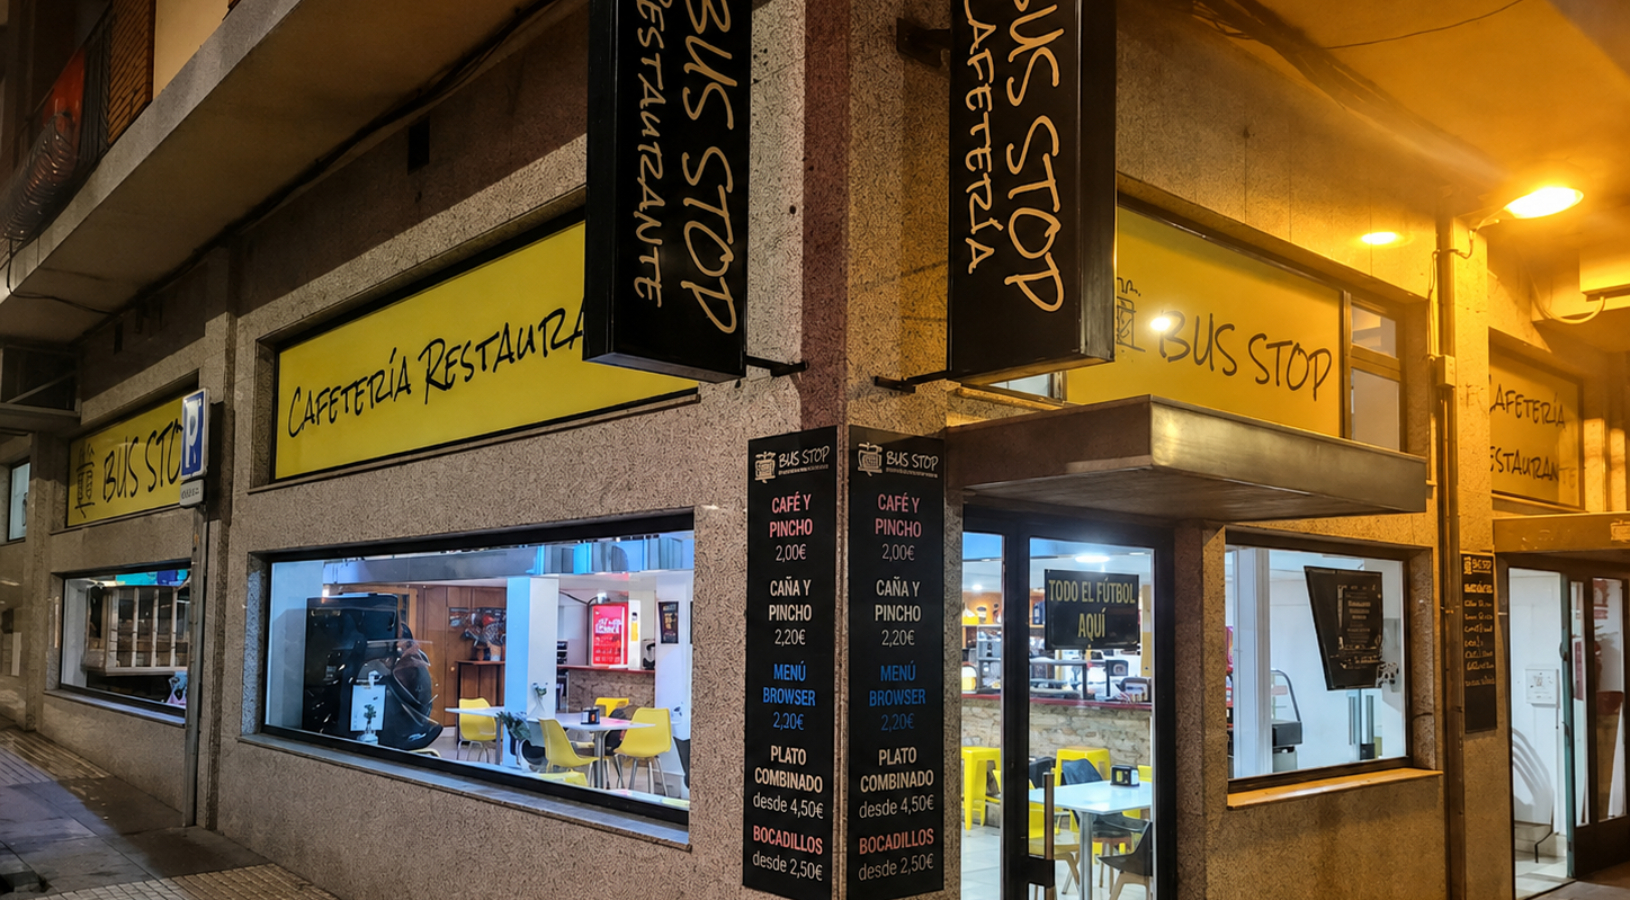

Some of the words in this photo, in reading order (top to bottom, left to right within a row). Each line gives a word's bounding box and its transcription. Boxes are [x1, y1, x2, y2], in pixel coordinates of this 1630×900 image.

[1006, 0, 1064, 107] US
[1004, 115, 1065, 312] STOP
[681, 146, 737, 334] STOP
[418, 298, 583, 405] RESTAURA
[1158, 310, 1238, 376] BUS
[1248, 333, 1332, 401] STOP
[103, 436, 139, 503] BUS
[145, 418, 183, 493] STO
[779, 451, 801, 467] BUS
[802, 446, 830, 464] STOP
[886, 451, 908, 468] BUS
[910, 454, 938, 471] STOP
[772, 491, 800, 513] CAFÉ
[803, 494, 811, 510] Y
[878, 493, 908, 512] CAFÉ
[912, 497, 919, 513] Y
[770, 519, 812, 537] PINCHO
[876, 518, 921, 537] PINCHO
[776, 544, 806, 562] 2,00€
[882, 544, 914, 561] 2,00€
[771, 576, 800, 596] CAÑA
[803, 580, 811, 595] Y
[877, 576, 909, 596] CAÑA
[913, 581, 920, 596] Y
[1049, 580, 1079, 601] TODO
[1082, 582, 1094, 602] EL
[1096, 578, 1136, 604] FÚTBOL
[769, 605, 811, 621] PINCHO
[875, 605, 921, 621] PINCHO
[1078, 607, 1106, 641] AQUÍ
[775, 629, 805, 646] 2,20€
[882, 630, 914, 647] 2,20€
[774, 661, 805, 681] MENÚ
[881, 661, 915, 681] MENÚ
[763, 687, 815, 706] BROWSER
[870, 689, 925, 706] BROWSER
[773, 712, 803, 730] 2,20€
[881, 713, 914, 731] 2,20€
[771, 746, 806, 765] PLATO
[879, 747, 916, 765] PLATO
[755, 767, 822, 793] COMBINADO
[861, 770, 933, 792] COMBINADO
[753, 792, 787, 812] desde
[790, 799, 823, 819] 4,50€
[859, 799, 897, 818] desde
[901, 794, 933, 814] 4,50€
[753, 826, 822, 855] BOCADILLOS
[860, 828, 933, 855] BOCADILLOS
[753, 851, 787, 872] desde
[790, 859, 822, 881] 2,50€
[859, 860, 897, 880] desde
[901, 853, 933, 874] 2,50€
